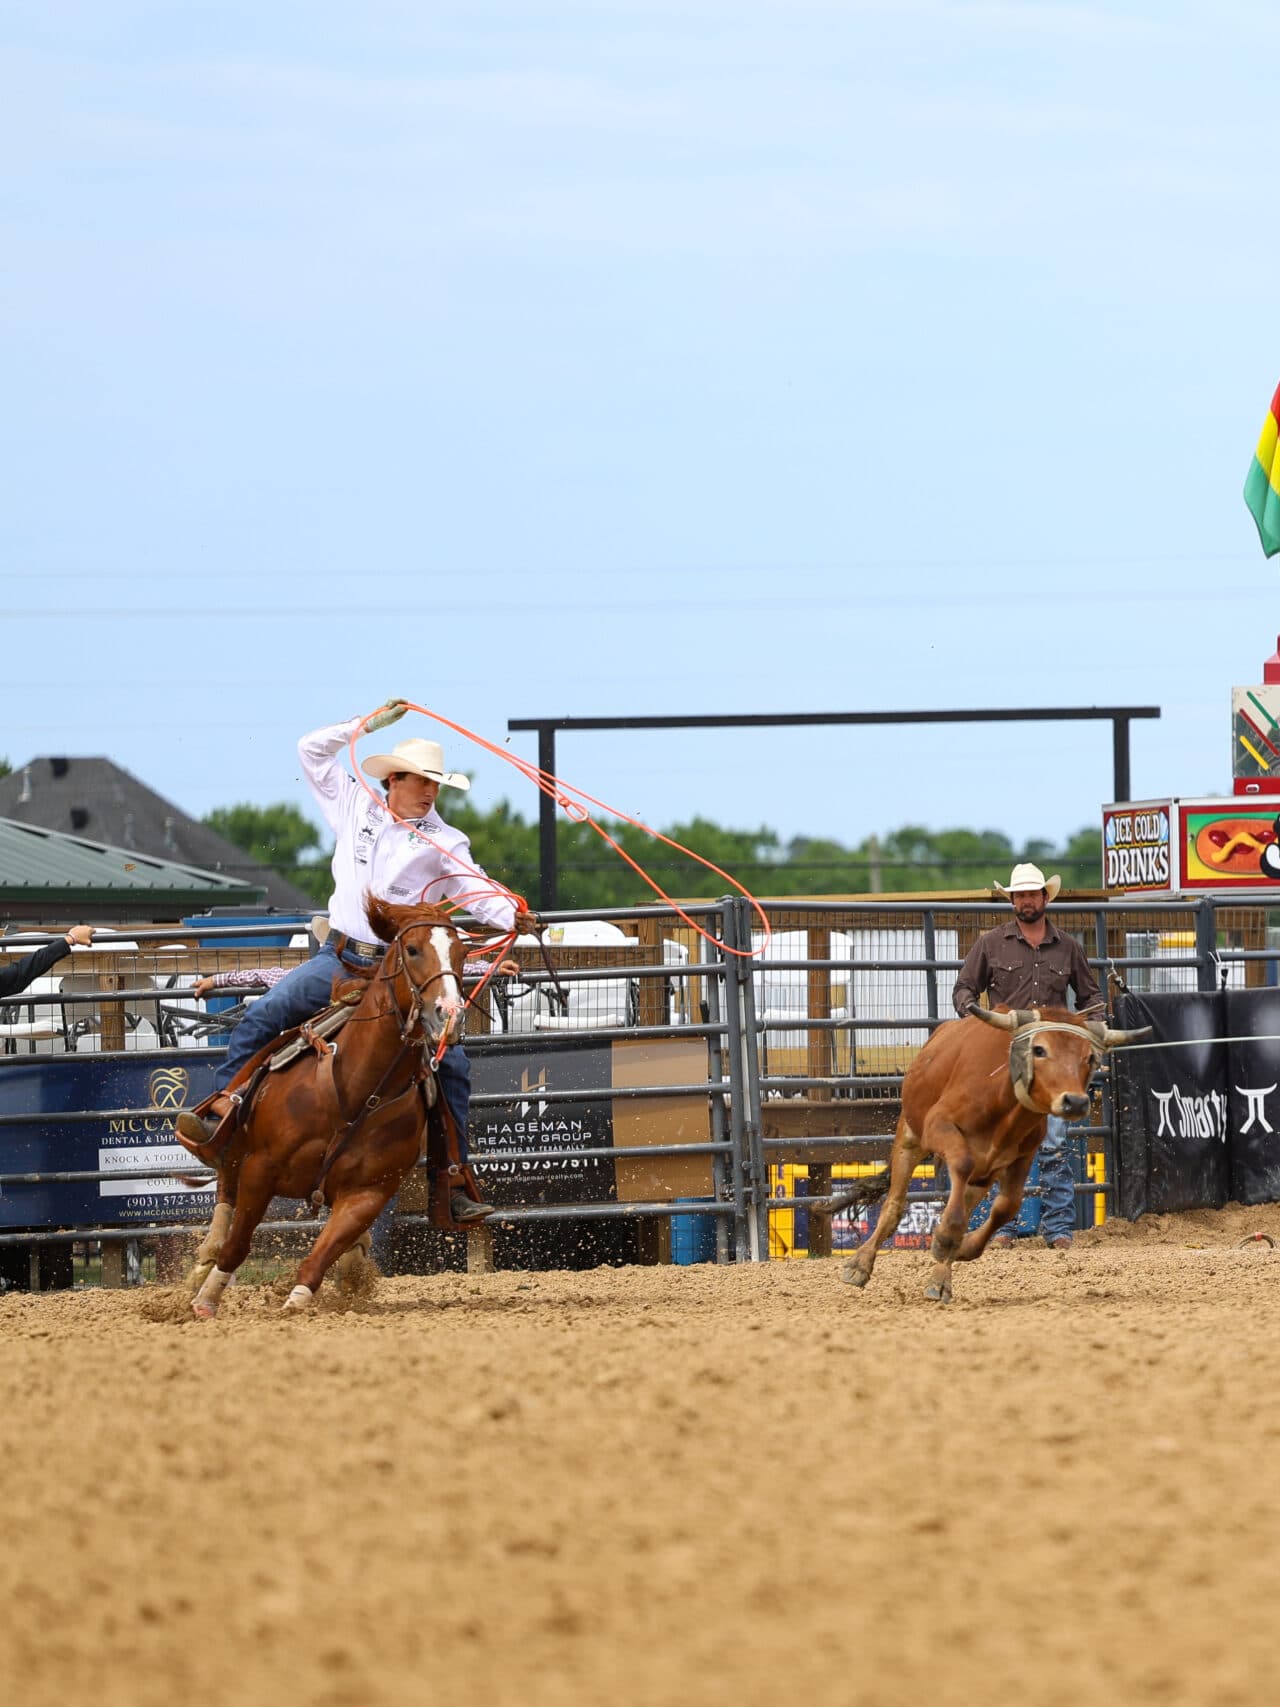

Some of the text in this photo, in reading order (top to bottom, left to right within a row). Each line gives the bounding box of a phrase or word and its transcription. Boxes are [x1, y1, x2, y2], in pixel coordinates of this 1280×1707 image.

[1115, 811, 1161, 844] ICE COLD
[1107, 844, 1169, 886] DRINKS
[1173, 1083, 1228, 1144] Smarty
[109, 1117, 175, 1134] MCCA
[487, 1120, 583, 1134] HAGEMAN
[101, 1134, 180, 1146] DENTAL & IMPL
[477, 1132, 592, 1146] REALTY GROUP
[104, 1153, 140, 1164] KNOCK
[144, 1154, 150, 1162] A
[153, 1152, 187, 1162] TOOTH
[127, 1195, 158, 1208] (903)
[118, 1206, 215, 1218] WWW.MCCAULEY-DENTA
